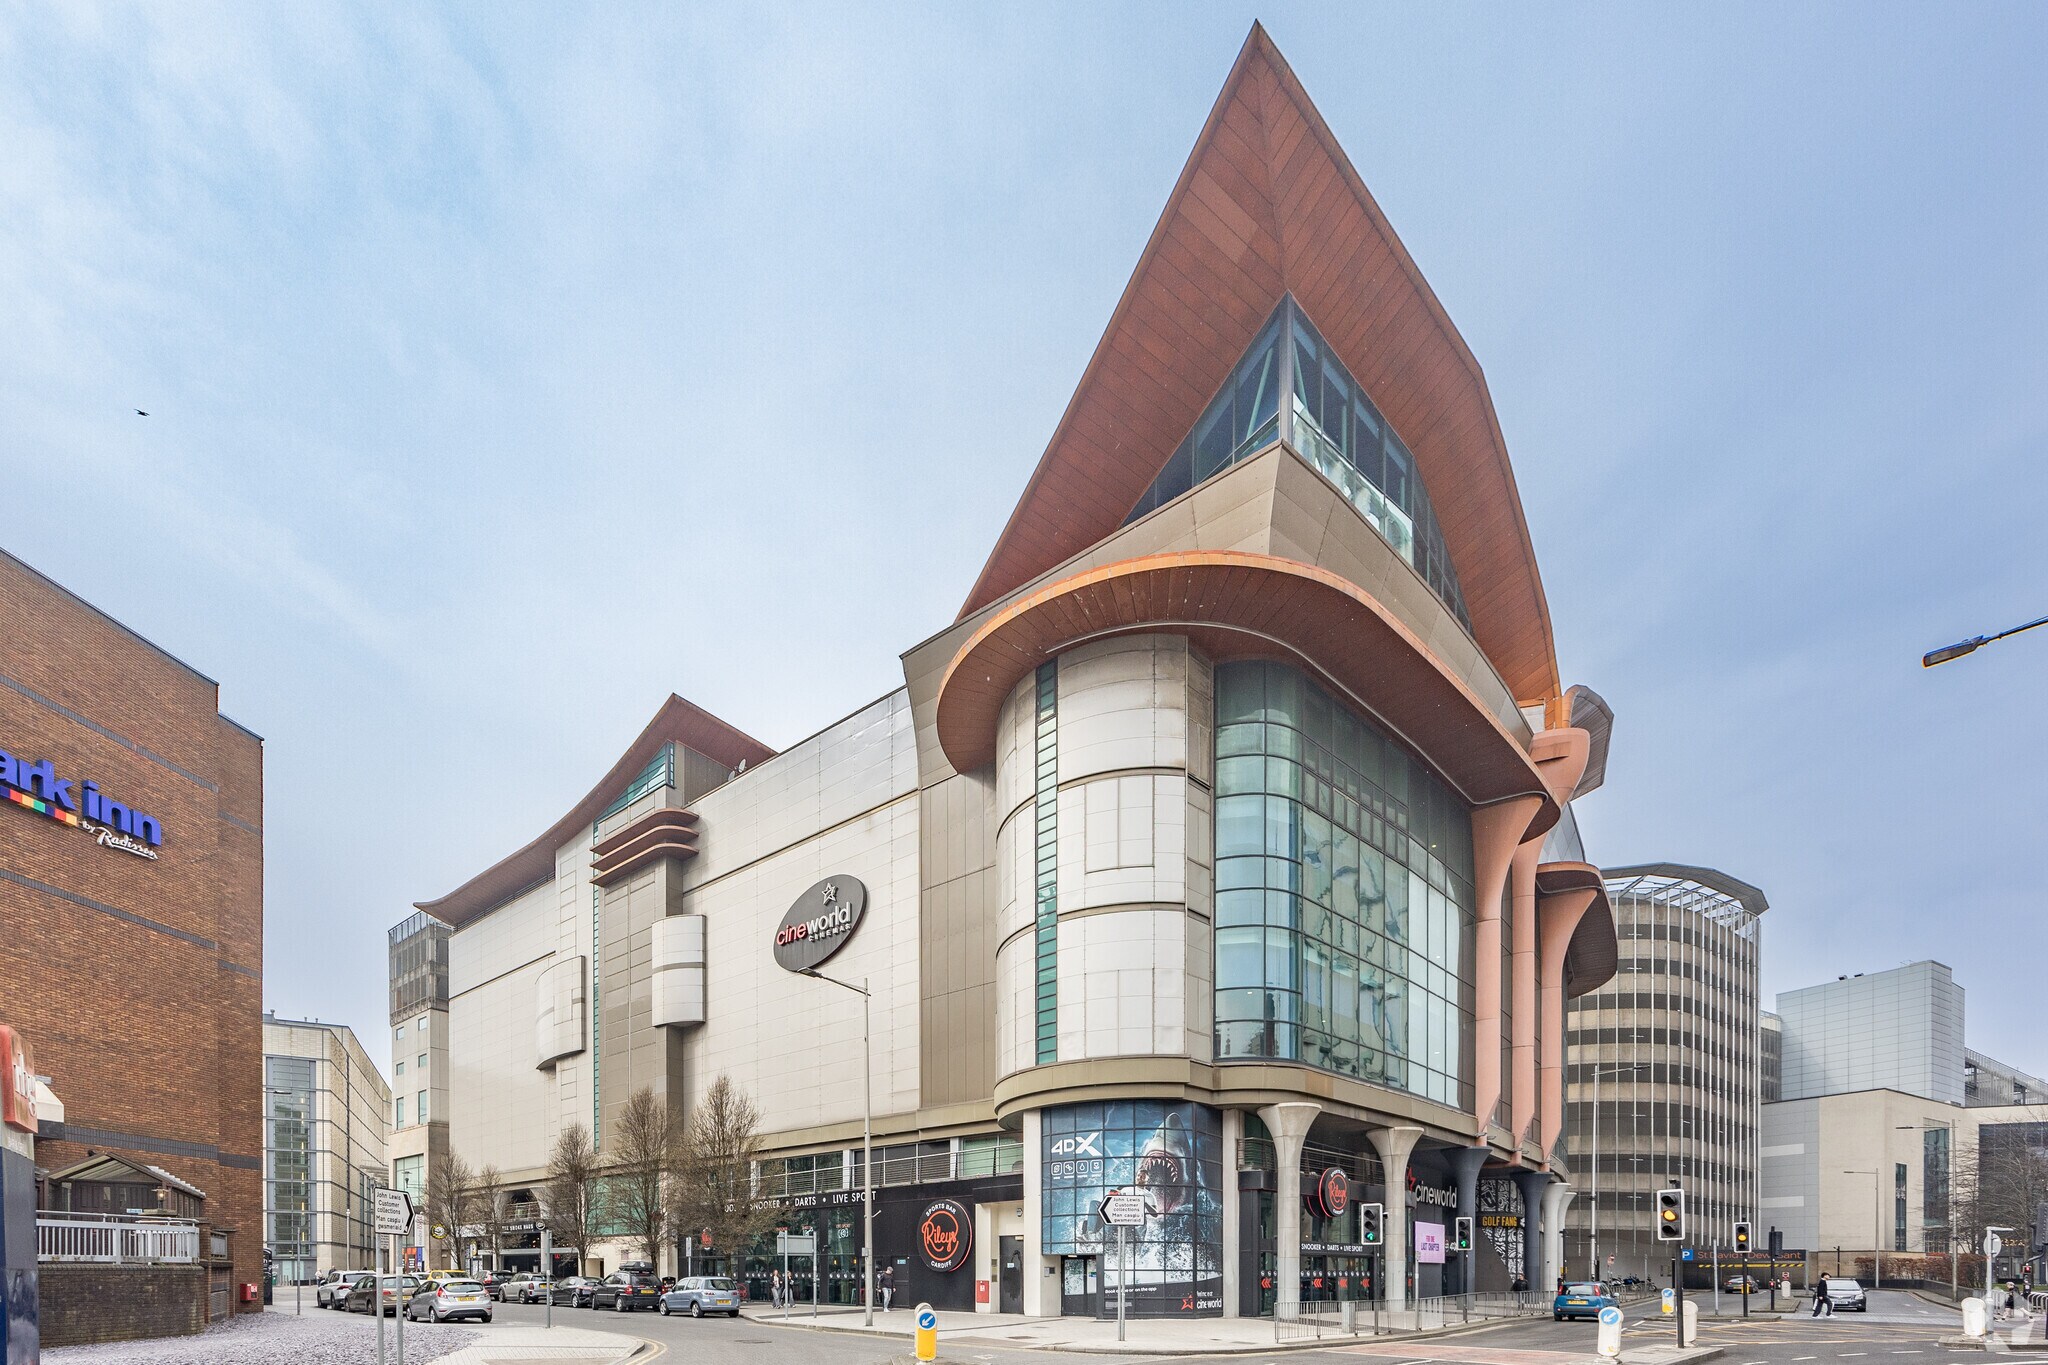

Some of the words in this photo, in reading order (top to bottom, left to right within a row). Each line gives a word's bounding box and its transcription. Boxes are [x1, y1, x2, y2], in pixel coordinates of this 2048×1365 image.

[0, 748, 76, 811] ark
[82, 780, 162, 847] inn
[80, 821, 96, 834] by
[96, 827, 158, 859] Radisson
[777, 902, 852, 946] cineworld
[808, 923, 851, 942] CINEMAS
[1051, 1132, 1103, 1156] 4DX
[750, 1199, 780, 1210] SNOOKER
[794, 1197, 816, 1206] DARTS
[832, 1193, 848, 1204] LIVE
[851, 1191, 876, 1202] SPOT
[1415, 1181, 1457, 1208] cineworld
[926, 1203, 945, 1216] SPORTS
[946, 1204, 956, 1214] BAR
[1482, 1216, 1500, 1227] GOLF
[922, 1215, 958, 1256] Rileys
[931, 1260, 952, 1269] CARDIFF
[1197, 1298, 1222, 1309] cineworld
